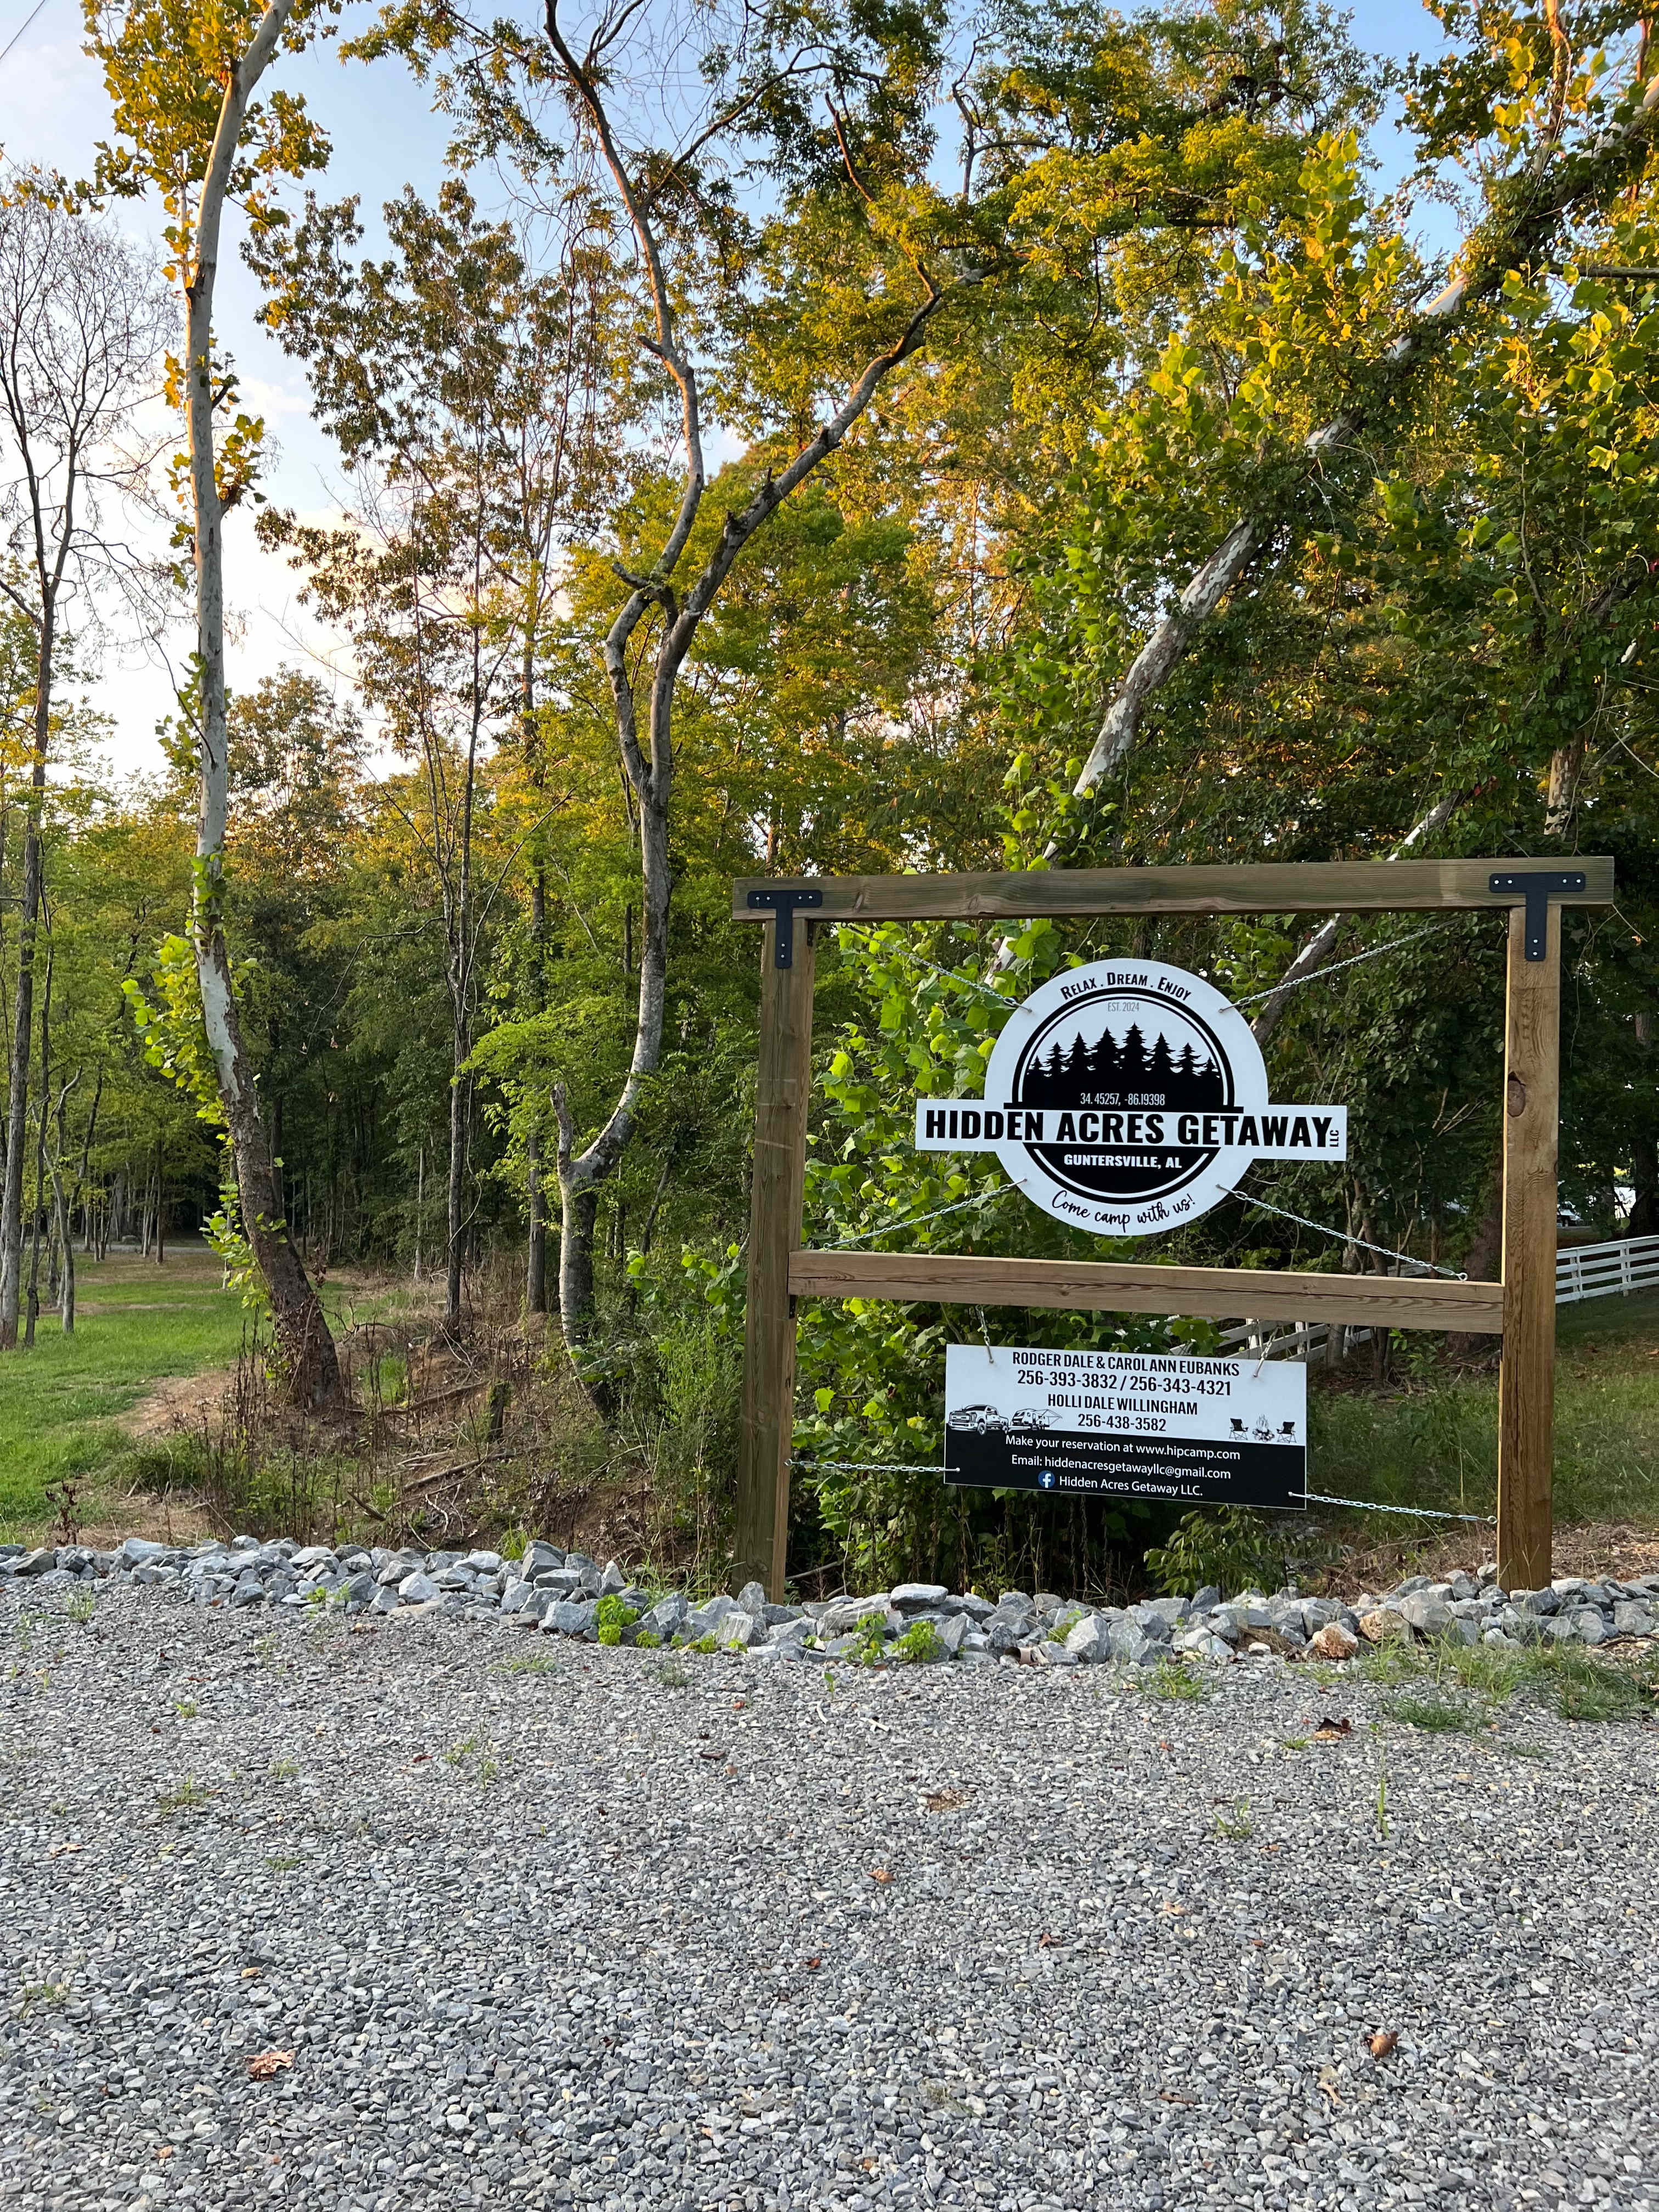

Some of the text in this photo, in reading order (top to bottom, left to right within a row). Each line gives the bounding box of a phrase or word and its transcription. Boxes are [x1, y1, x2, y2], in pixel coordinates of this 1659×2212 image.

[1060, 978, 1097, 1000] RELAX
[1107, 972, 1148, 986] DREAM
[1158, 977, 1192, 1001] ENJOY
[1108, 1002, 1139, 1012] EST. 2024
[1125, 1093, 1165, 1105] -86.19398
[926, 1110, 1332, 1147] HIDDEN ACRES GETAWAY
[1329, 1130, 1339, 1147] LLC
[1064, 1154, 1182, 1169] GUNTERSVILLE, AL
[1052, 1190, 1195, 1233] Come camp with us!
[1013, 1351, 1061, 1367] RODGER
[1064, 1355, 1094, 1369] DALE
[1096, 1356, 1105, 1368] &
[1180, 1361, 1239, 1376] EUBANKS
[1018, 1369, 1117, 1390] 256-393-3832
[1130, 1376, 1231, 1396] 256-343-4321
[1048, 1393, 1197, 1415] HOLLI DALE WILLINGHAM
[1078, 1414, 1166, 1431] 256-438-3582
[1006, 1435, 1240, 1460] Make your reservation at www.hipcamp.com
[1012, 1454, 1231, 1479] Email: hiddenacresgetawayllc@gmail.com
[1059, 1476, 1097, 1488] Hidden
[1101, 1480, 1129, 1491] Acres
[1132, 1481, 1178, 1497] Getaway
[1181, 1485, 1203, 1496] LLC.
